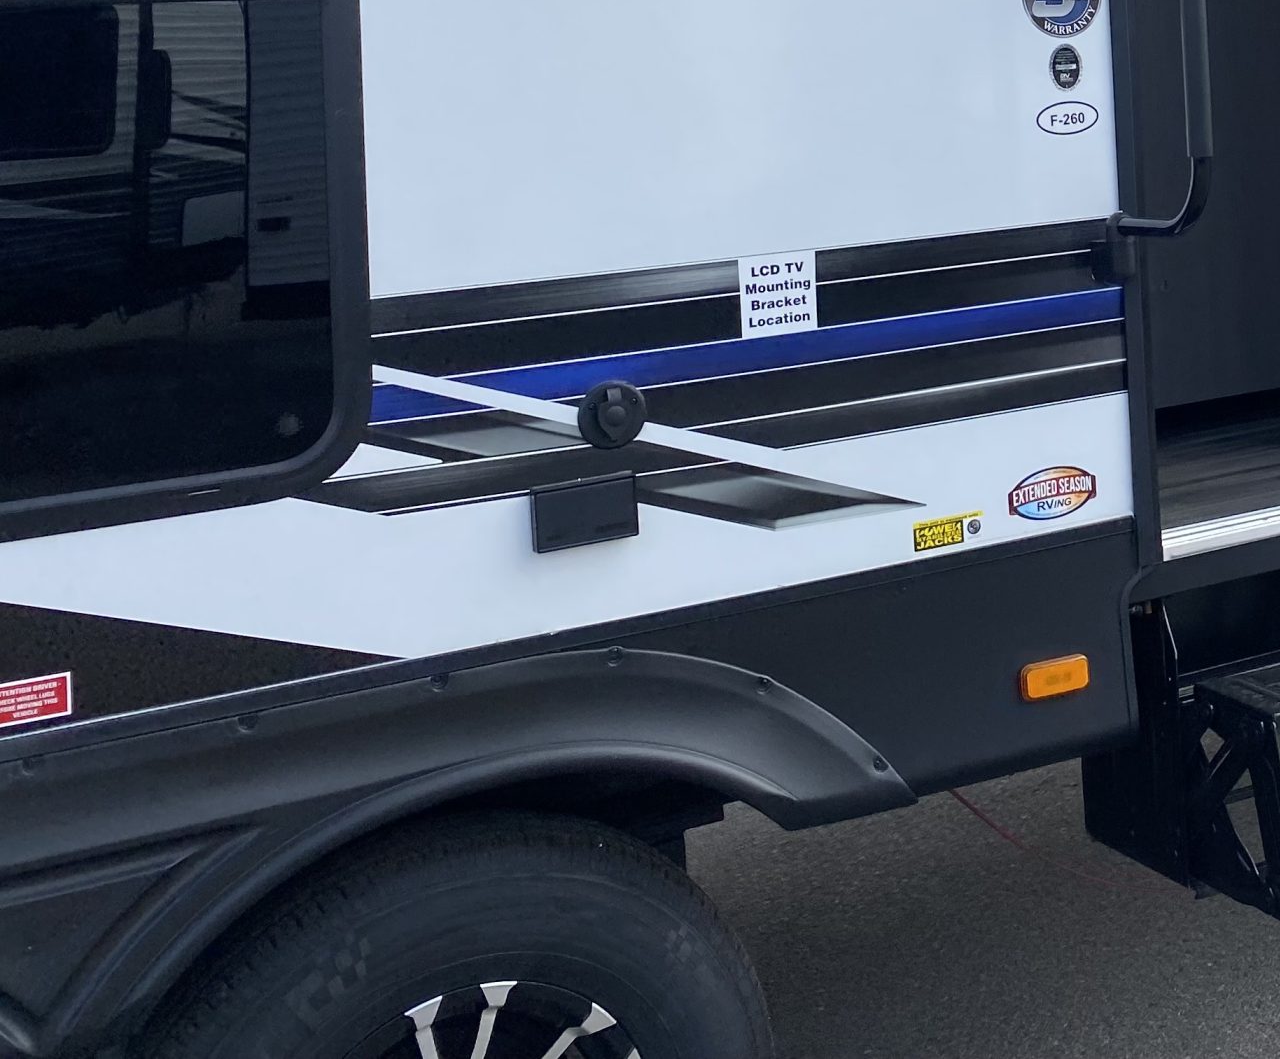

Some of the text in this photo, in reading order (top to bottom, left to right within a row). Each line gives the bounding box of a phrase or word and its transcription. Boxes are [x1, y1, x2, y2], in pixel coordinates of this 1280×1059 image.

[1043, 4, 1096, 35] WARRANTY
[1050, 112, 1085, 127] F-260
[751, 262, 803, 277] LCD TV
[745, 279, 810, 294] Mounting
[751, 295, 807, 310] Bracket
[749, 312, 810, 327] Location
[1012, 475, 1093, 507] EXTENDED SEASON
[916, 534, 963, 550] JACKS
[0, 686, 31, 697] TTENTION
[33, 682, 57, 691] DRIVER
[44, 697, 58, 706] THIS
